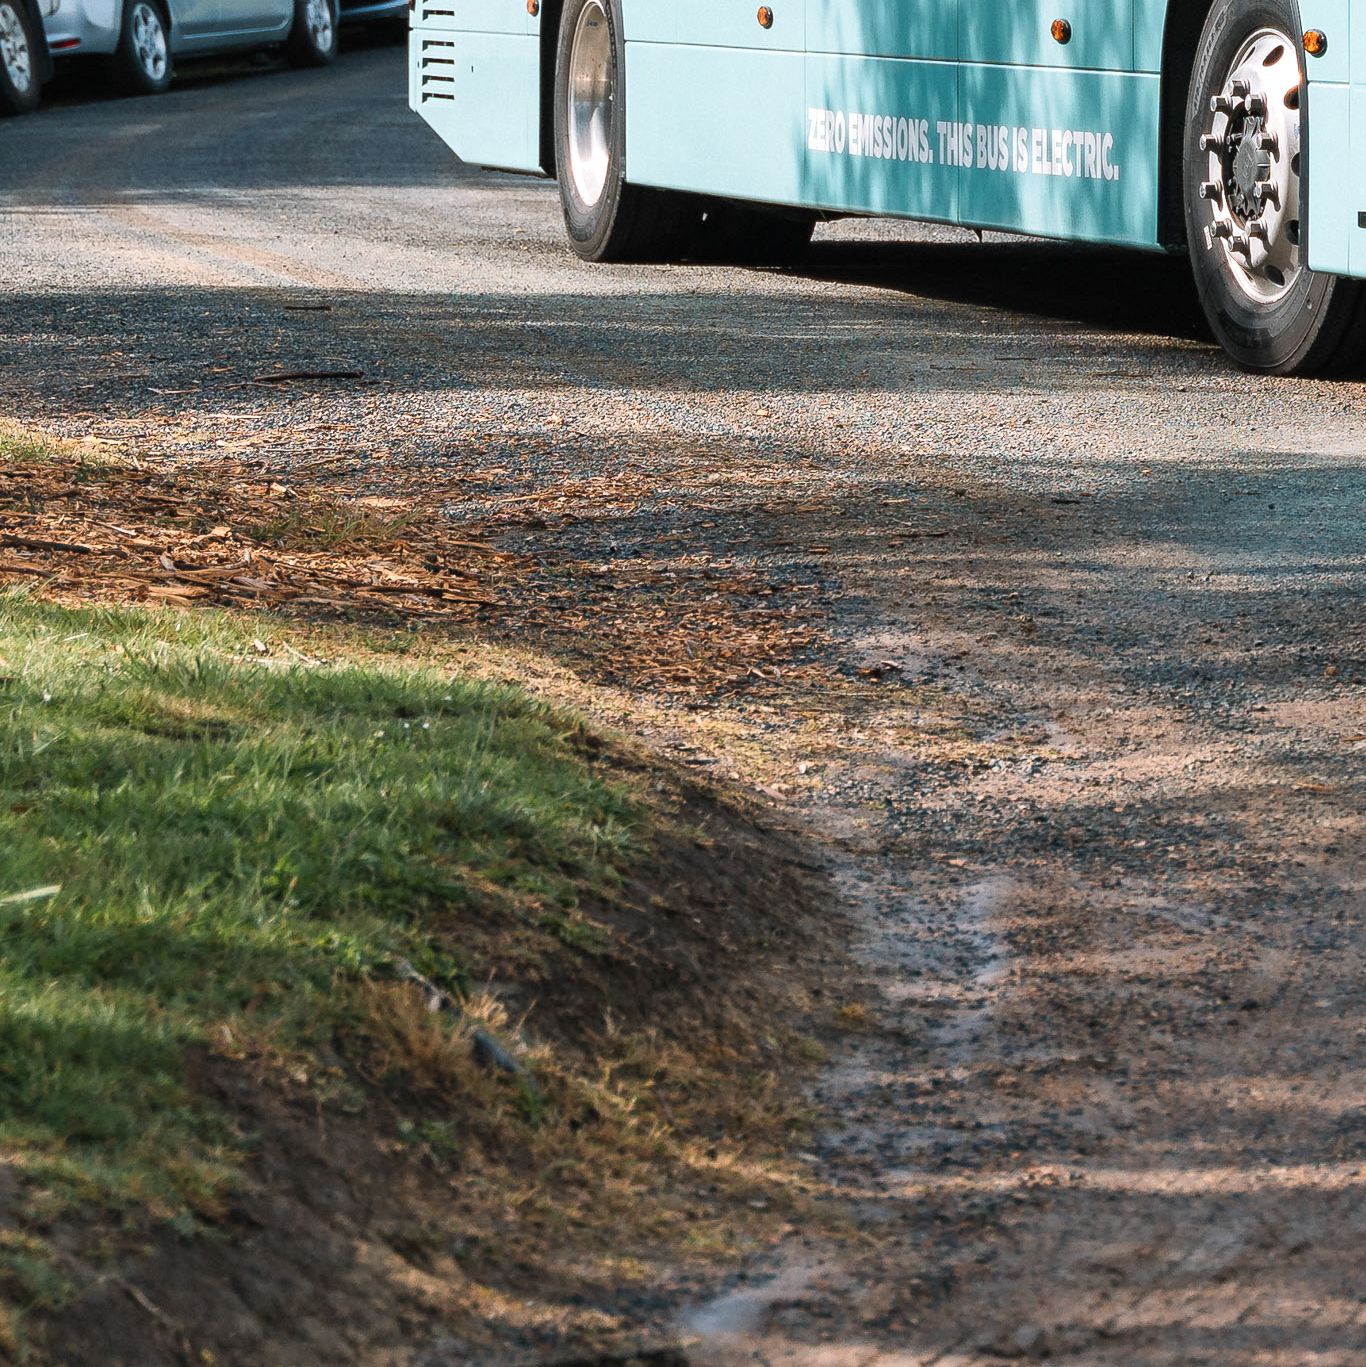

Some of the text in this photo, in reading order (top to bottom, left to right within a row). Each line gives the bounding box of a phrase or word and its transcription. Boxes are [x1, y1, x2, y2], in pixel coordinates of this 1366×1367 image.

[807, 107, 1120, 181] ZERO EMISSIONS. THIS BUS IS ELECTRIC.
